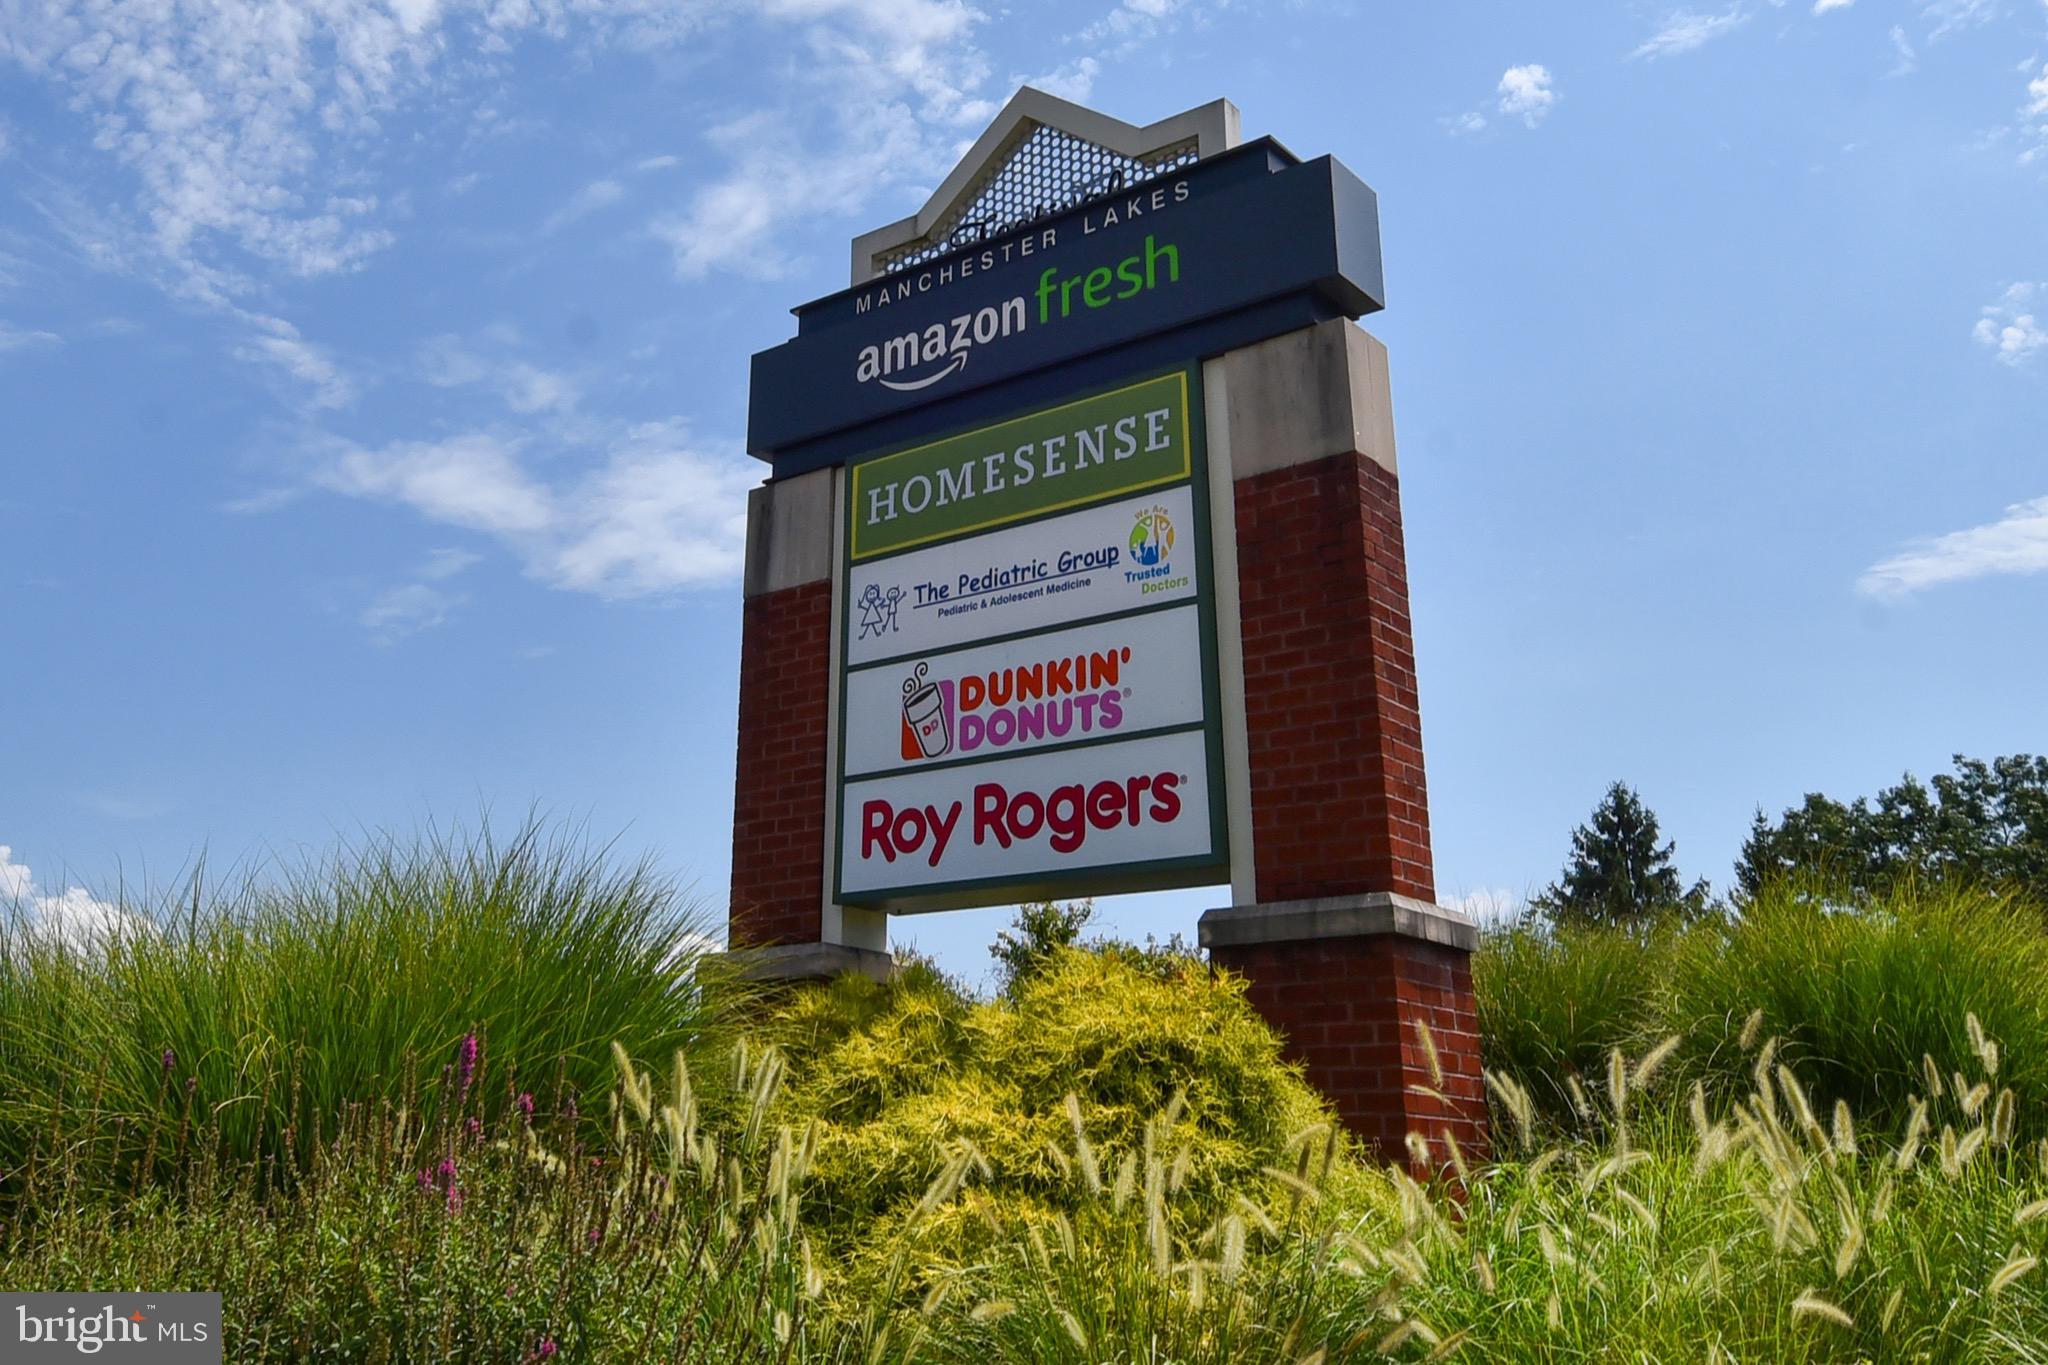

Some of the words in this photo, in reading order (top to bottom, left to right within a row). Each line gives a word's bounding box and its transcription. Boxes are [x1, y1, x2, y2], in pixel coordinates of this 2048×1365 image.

[856, 228, 1056, 314] MANCHESTER
[1083, 181, 1189, 235] LAKES
[856, 296, 1027, 383] amazon
[1034, 235, 1180, 324] fresh
[866, 408, 1171, 526] HOMESENSE
[1135, 508, 1150, 520] We
[1153, 504, 1168, 515] Are
[914, 583, 950, 604] The
[958, 559, 1048, 595] Pediatric
[1057, 545, 1120, 573] Group
[938, 601, 978, 618] Pediatric
[980, 599, 988, 609] &
[990, 587, 1045, 607] Adolescent
[1046, 577, 1092, 595] Medicine
[1124, 563, 1170, 583] Trusted
[1142, 576, 1189, 595] Doctors
[959, 646, 1131, 713] DUNKIN'
[861, 799, 963, 867] Roy
